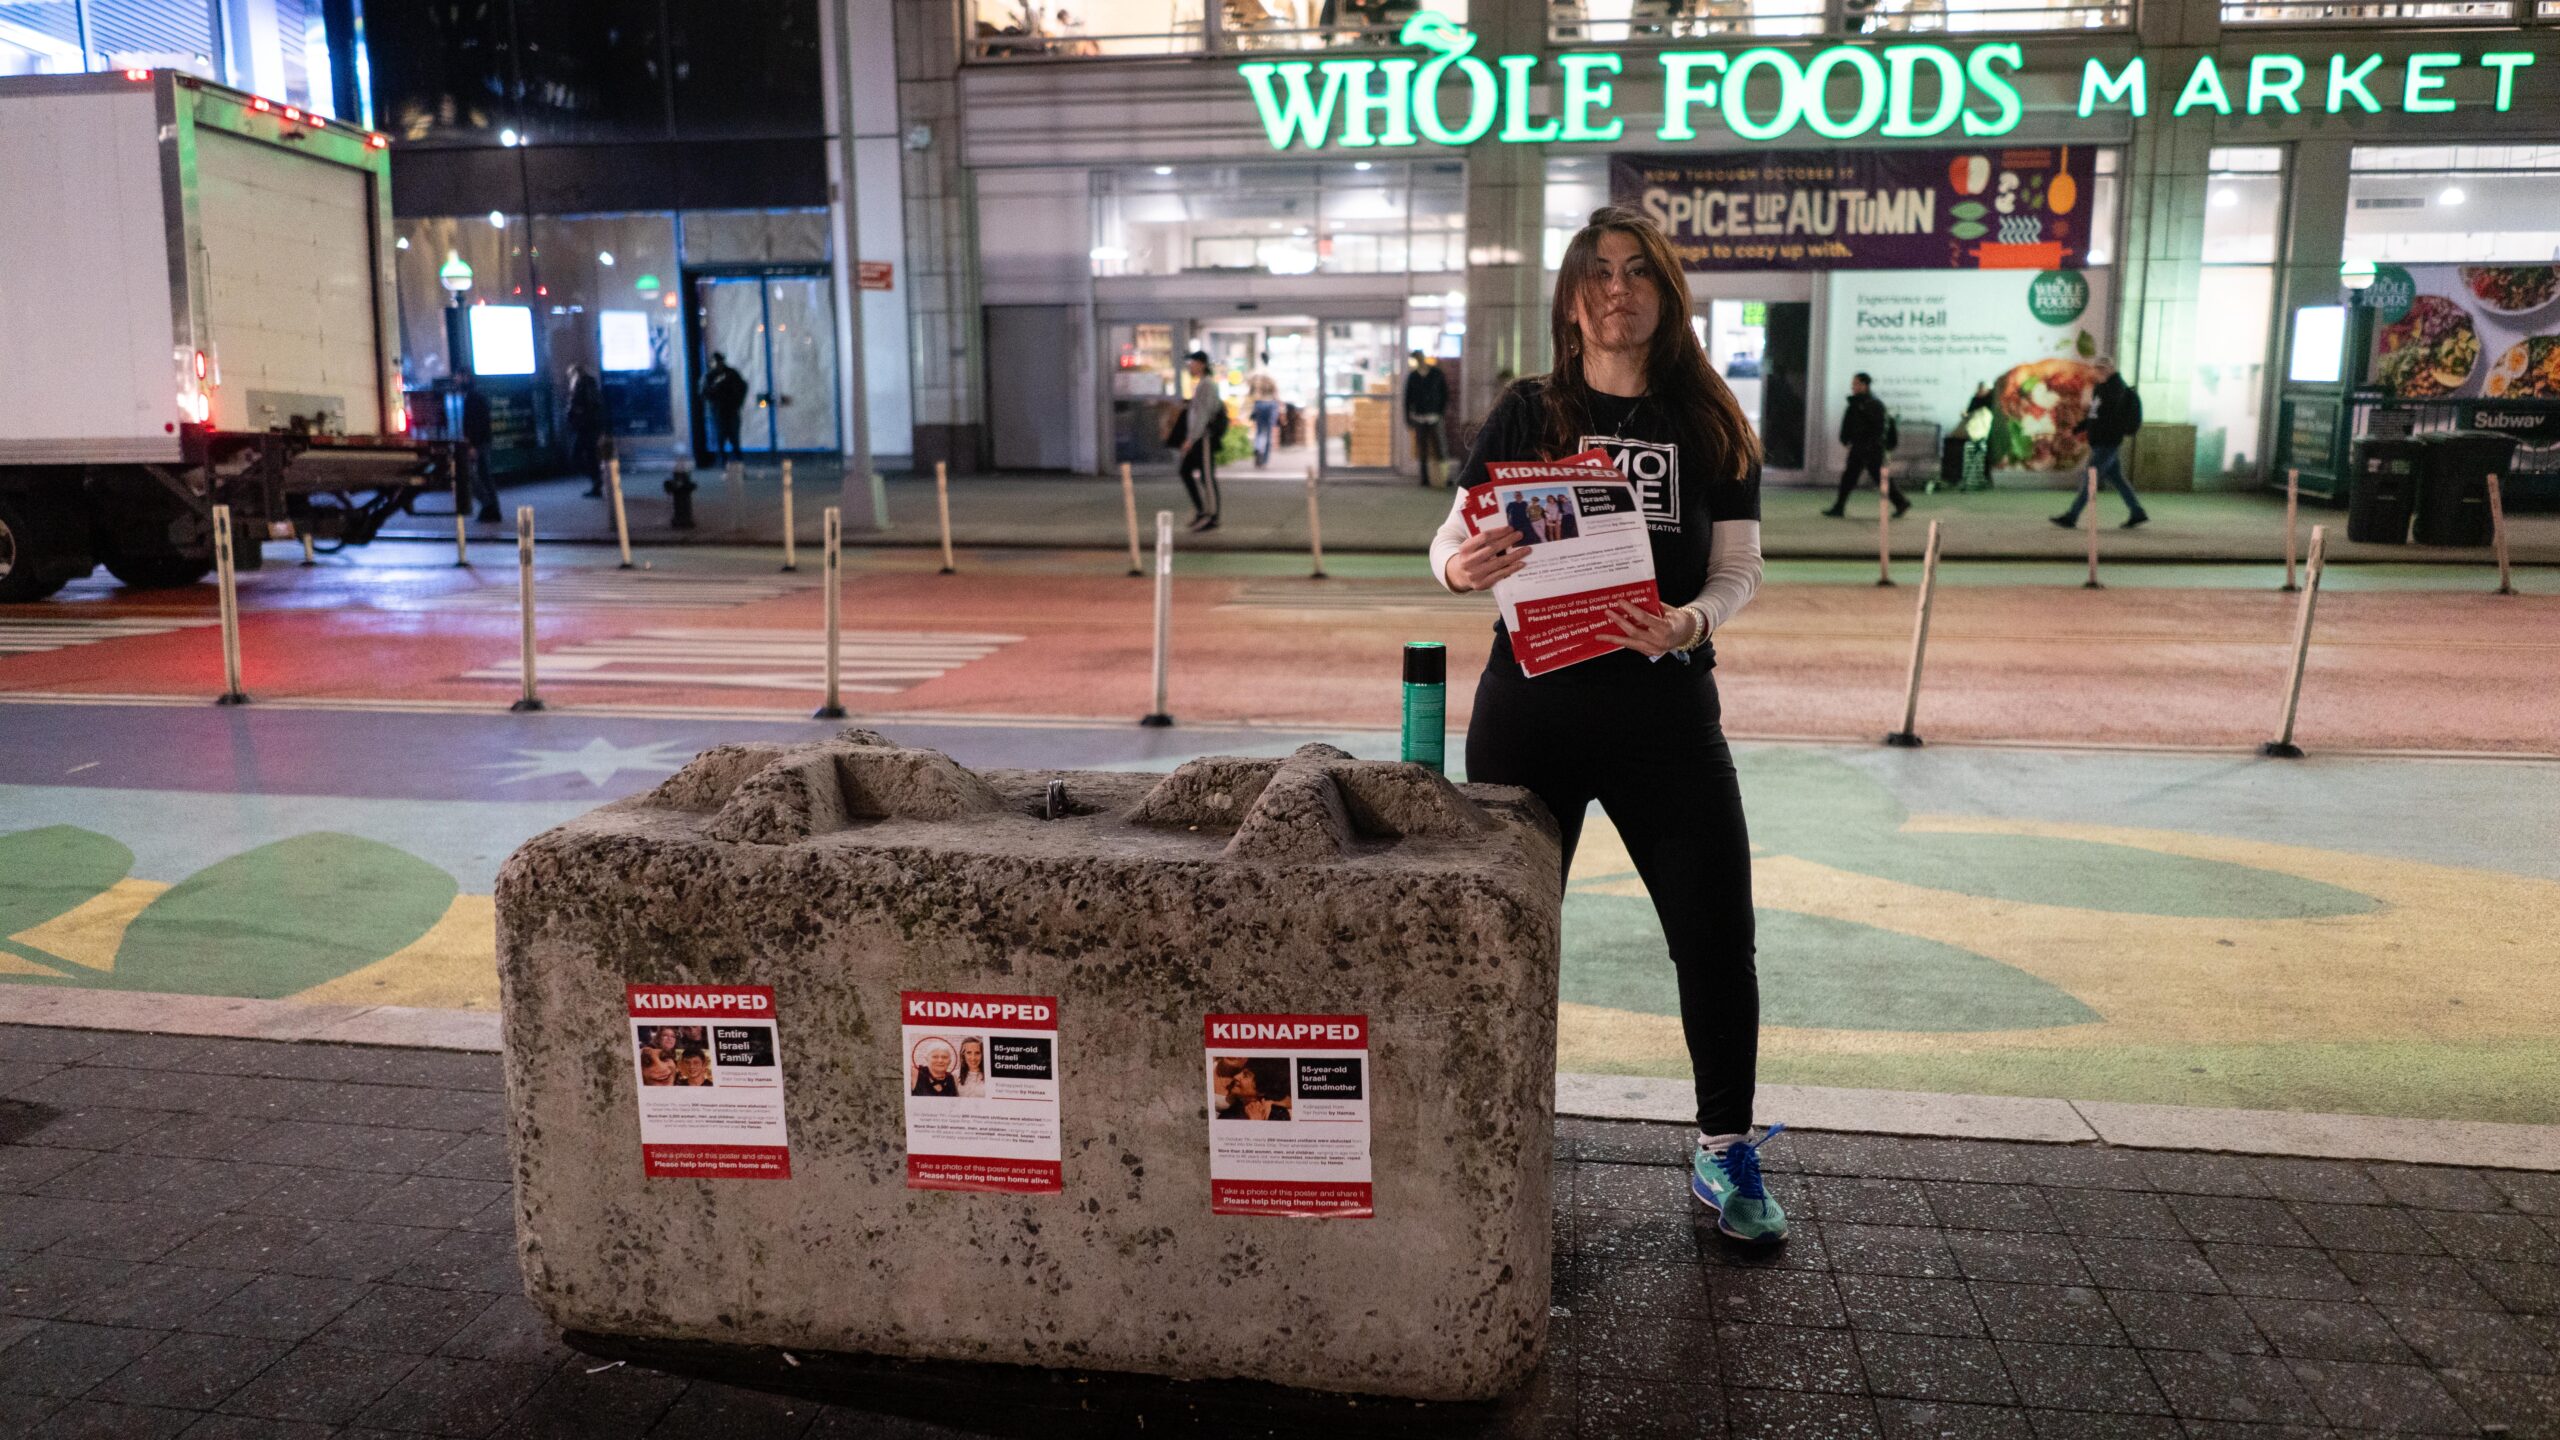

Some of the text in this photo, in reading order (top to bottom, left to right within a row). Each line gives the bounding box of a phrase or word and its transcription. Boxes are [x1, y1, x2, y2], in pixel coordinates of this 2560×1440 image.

[1238, 43, 2535, 150] WHOLE FOODS MARKET
[1713, 245, 1732, 258] to
[1735, 245, 1776, 261] cozy
[1780, 245, 1804, 260] up
[1857, 309, 1946, 327] Food Hall
[1495, 467, 1620, 480] KIDNAPPED
[1577, 487, 1607, 495] Entire
[1580, 495, 1611, 503] Israeli
[1583, 504, 1616, 512] Family
[1646, 524, 1681, 534] REATIVE
[1547, 603, 1566, 612] photo
[1575, 598, 1588, 606] this
[1611, 591, 1625, 599] and
[1528, 614, 1551, 622] Please
[1552, 610, 1568, 618] help
[1569, 607, 1588, 616] bring
[1589, 604, 1608, 612] them
[1530, 639, 1553, 649] Please
[1554, 632, 1569, 642] help
[1570, 626, 1589, 637] bring
[1589, 622, 1608, 630] them
[634, 993, 767, 1010] KIDNAPPED
[909, 1000, 1050, 1021] KIDNAPPED
[717, 1029, 748, 1038] Entire
[1212, 1023, 1360, 1040] KIDNAPPED
[719, 1041, 750, 1050] Israeli
[994, 1044, 1038, 1053] 85-year-old
[720, 1053, 753, 1064] Family
[994, 1053, 1018, 1061] Israeli
[994, 1062, 1047, 1071] Grandmother
[1301, 1066, 1347, 1074] 85-year-old
[1302, 1083, 1356, 1091] Grandmother
[675, 1152, 696, 1160] photo
[680, 1161, 697, 1170] help
[698, 1162, 718, 1170] bring
[942, 1163, 962, 1172] photo
[972, 1164, 986, 1172] this
[1011, 1166, 1026, 1174] and
[919, 1171, 944, 1180] Please
[946, 1173, 963, 1181] help
[964, 1174, 985, 1182] bring
[1246, 1188, 1267, 1197] photo
[1223, 1197, 1249, 1205] Please
[1251, 1198, 1269, 1206] help
[1271, 1199, 1291, 1207] bring
